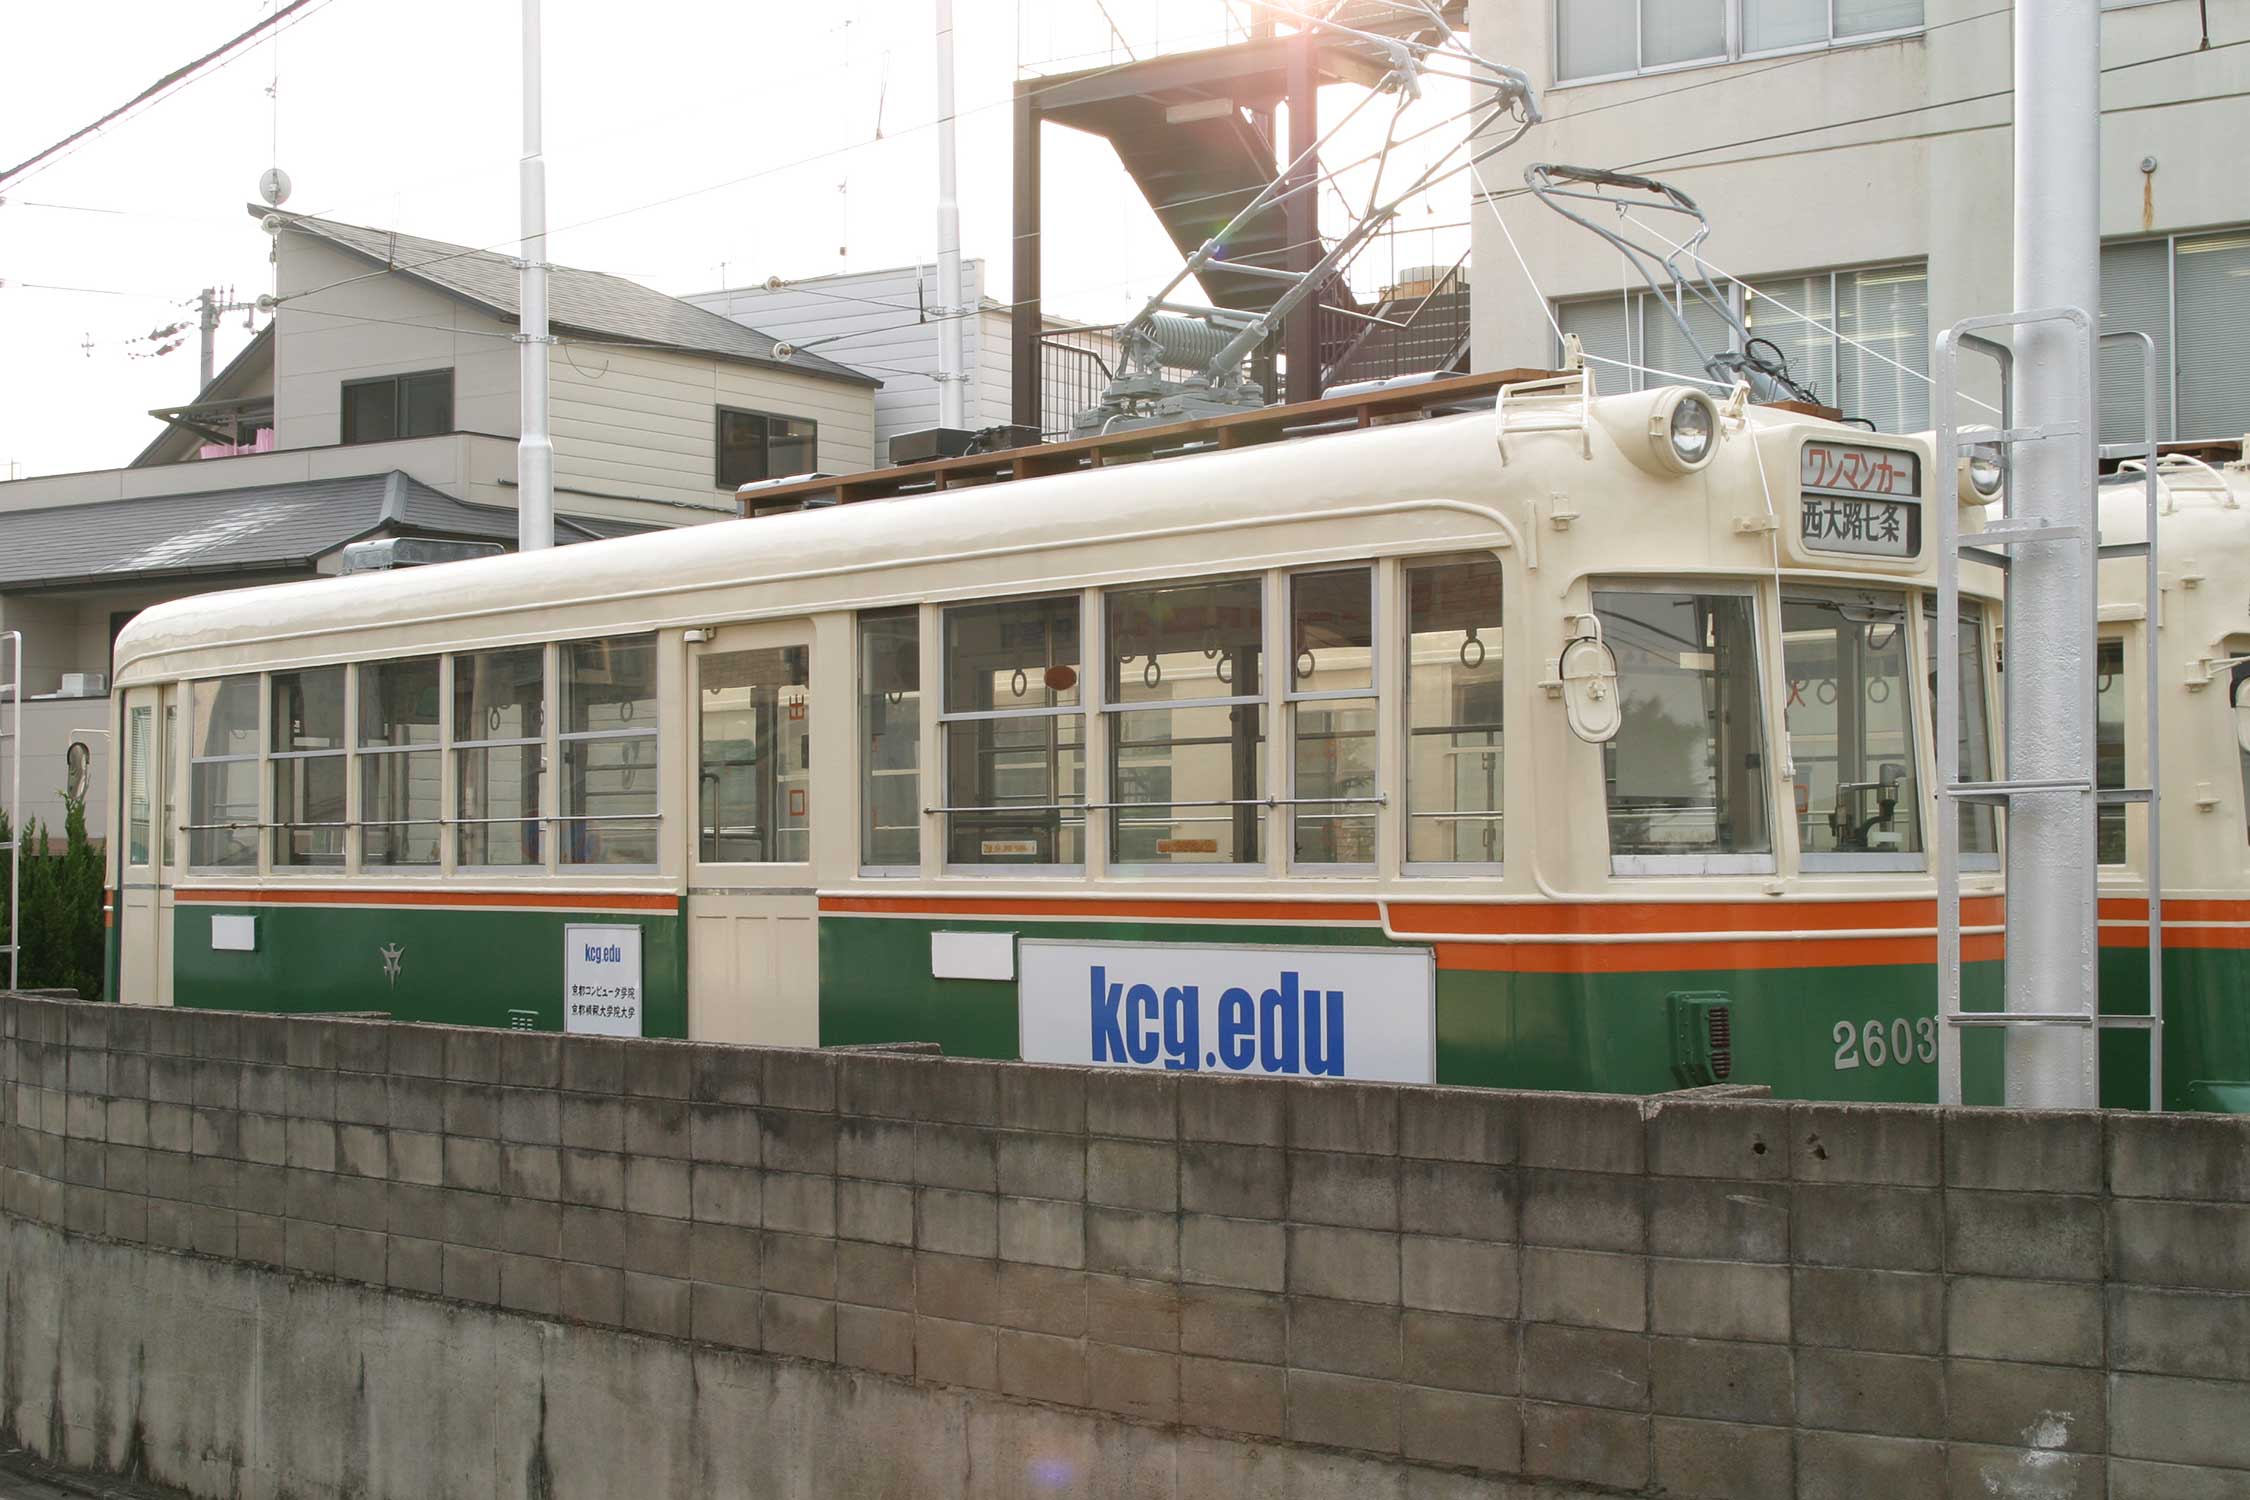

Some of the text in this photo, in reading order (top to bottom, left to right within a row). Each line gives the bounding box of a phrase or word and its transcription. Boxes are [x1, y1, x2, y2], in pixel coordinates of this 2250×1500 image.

[1808, 448, 1906, 493] ワンマンカー
[1801, 501, 1900, 543] 西大路七条
[789, 693, 805, 817] 出口
[584, 943, 621, 964] kcg.edu
[571, 984, 635, 1000] 京都コンピュータ学院
[1090, 966, 1344, 1077] kcg.edu
[1832, 1017, 1937, 1070] 2603
